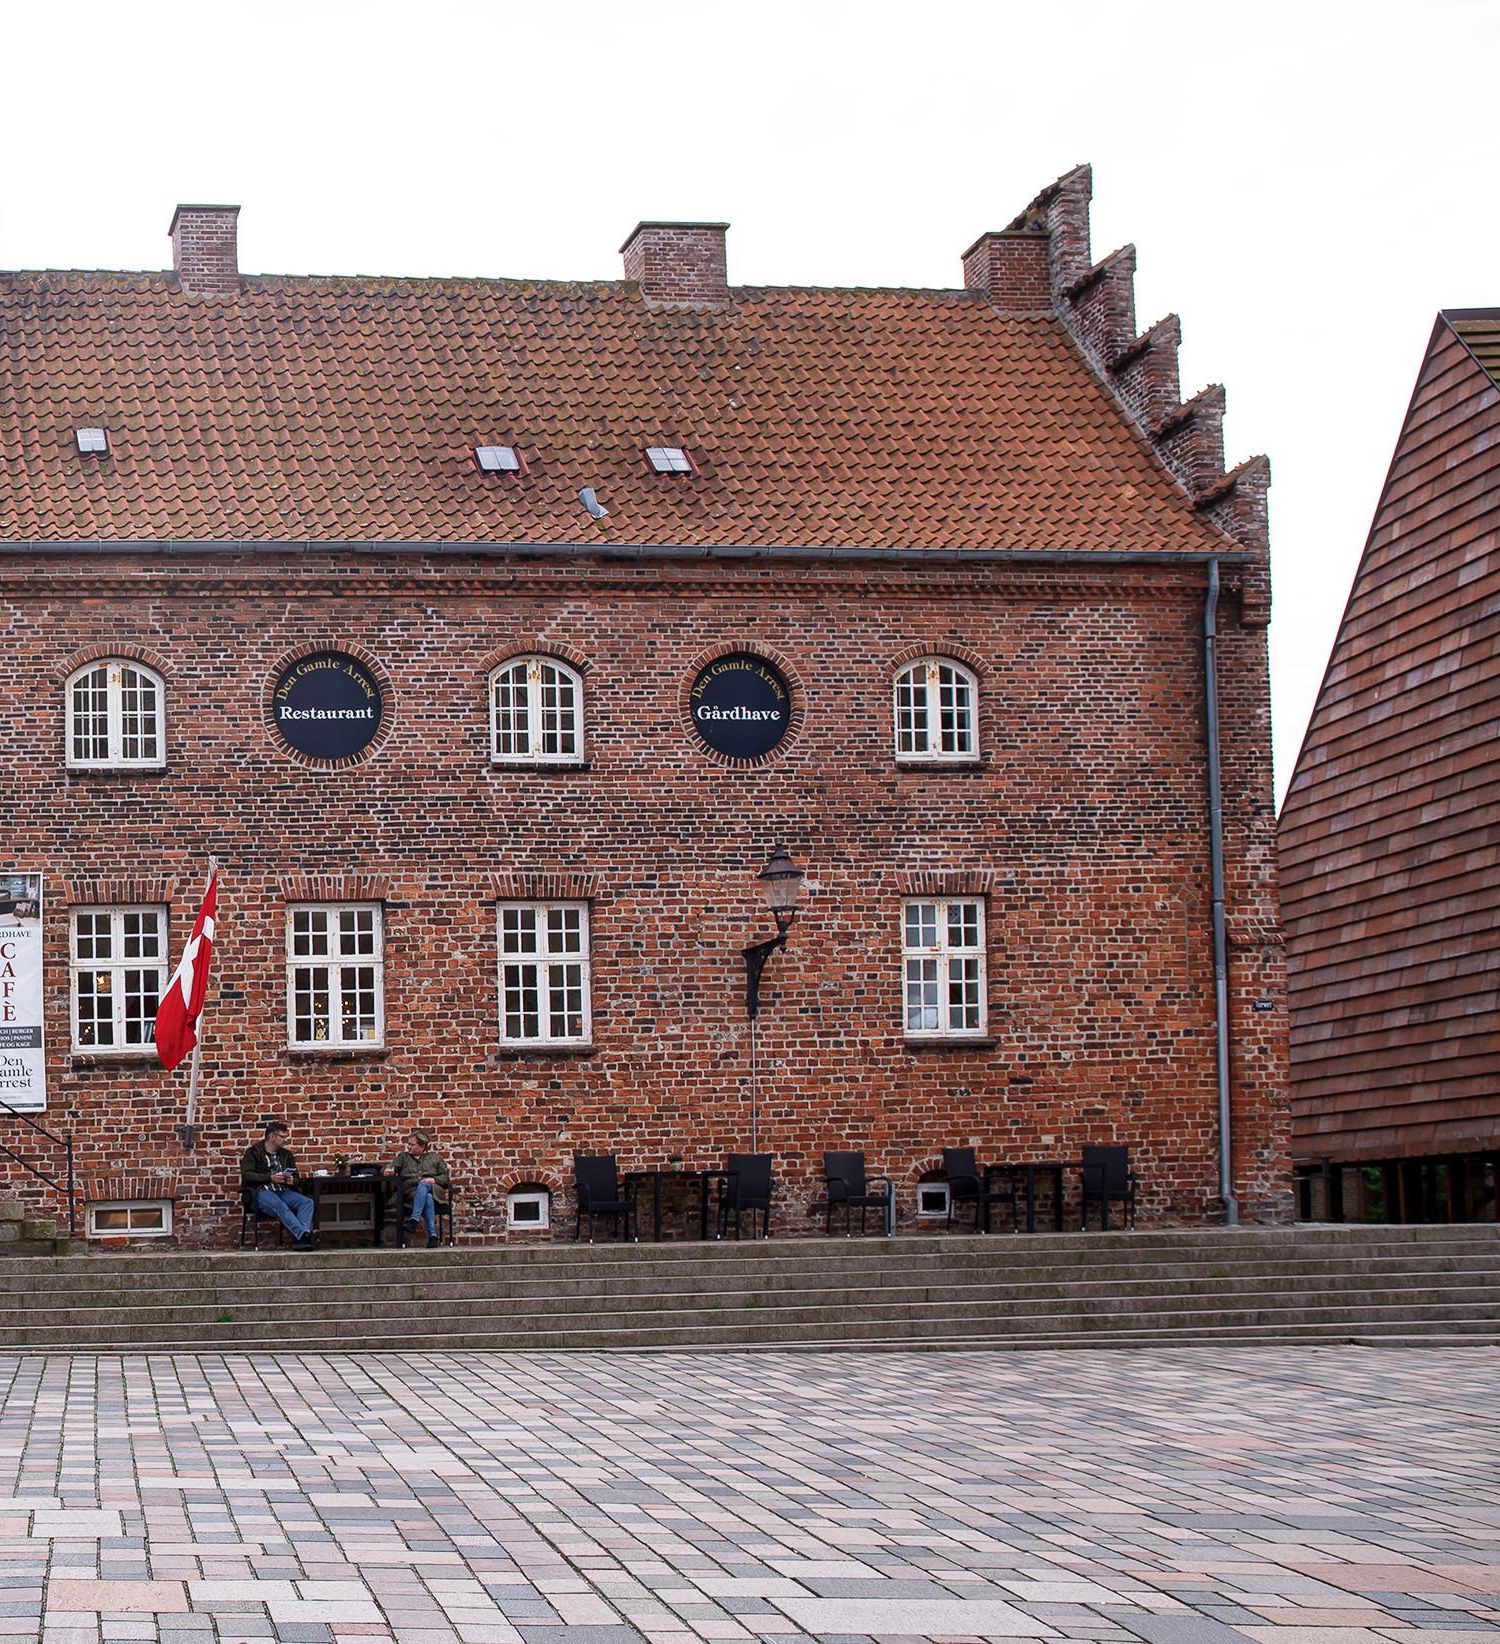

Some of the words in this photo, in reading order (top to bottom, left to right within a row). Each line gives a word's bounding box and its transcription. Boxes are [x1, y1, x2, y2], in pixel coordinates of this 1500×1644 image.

[277, 677, 297, 701] Den
[296, 658, 340, 676] Gamle
[342, 664, 376, 700] Arrest
[692, 675, 712, 699] Den
[711, 660, 753, 676] Gamle
[756, 665, 786, 701] Arrest
[279, 706, 374, 720] Restaurant
[697, 705, 781, 721] Gårdhave
